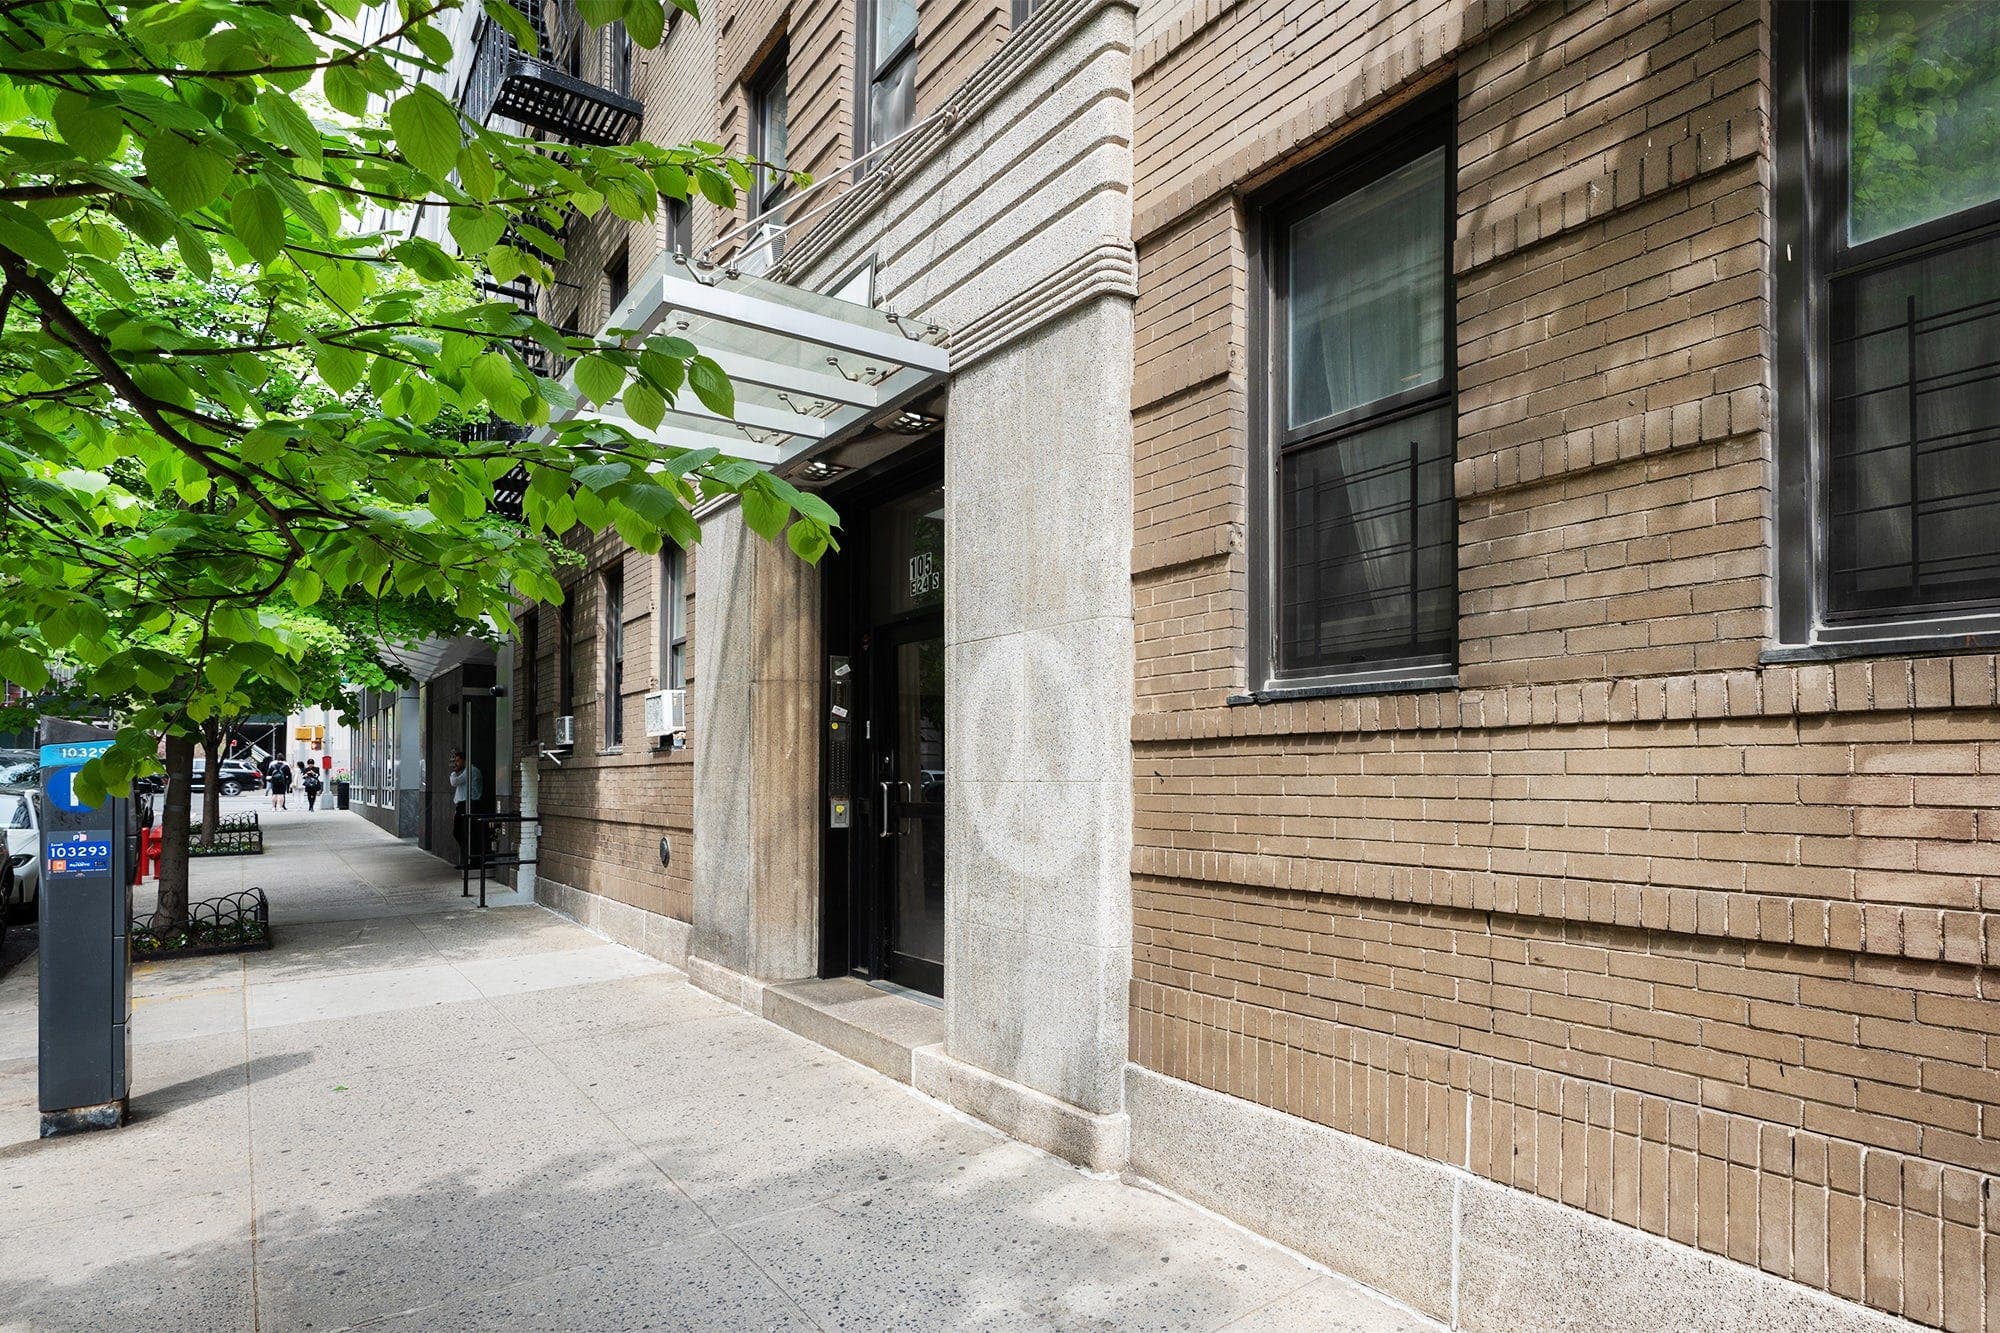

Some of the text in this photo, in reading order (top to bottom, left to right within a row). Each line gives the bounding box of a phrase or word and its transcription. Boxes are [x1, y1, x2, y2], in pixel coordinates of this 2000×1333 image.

[910, 553, 931, 579] 105
[62, 744, 115, 758] 10329
[51, 846, 107, 858] 103293
